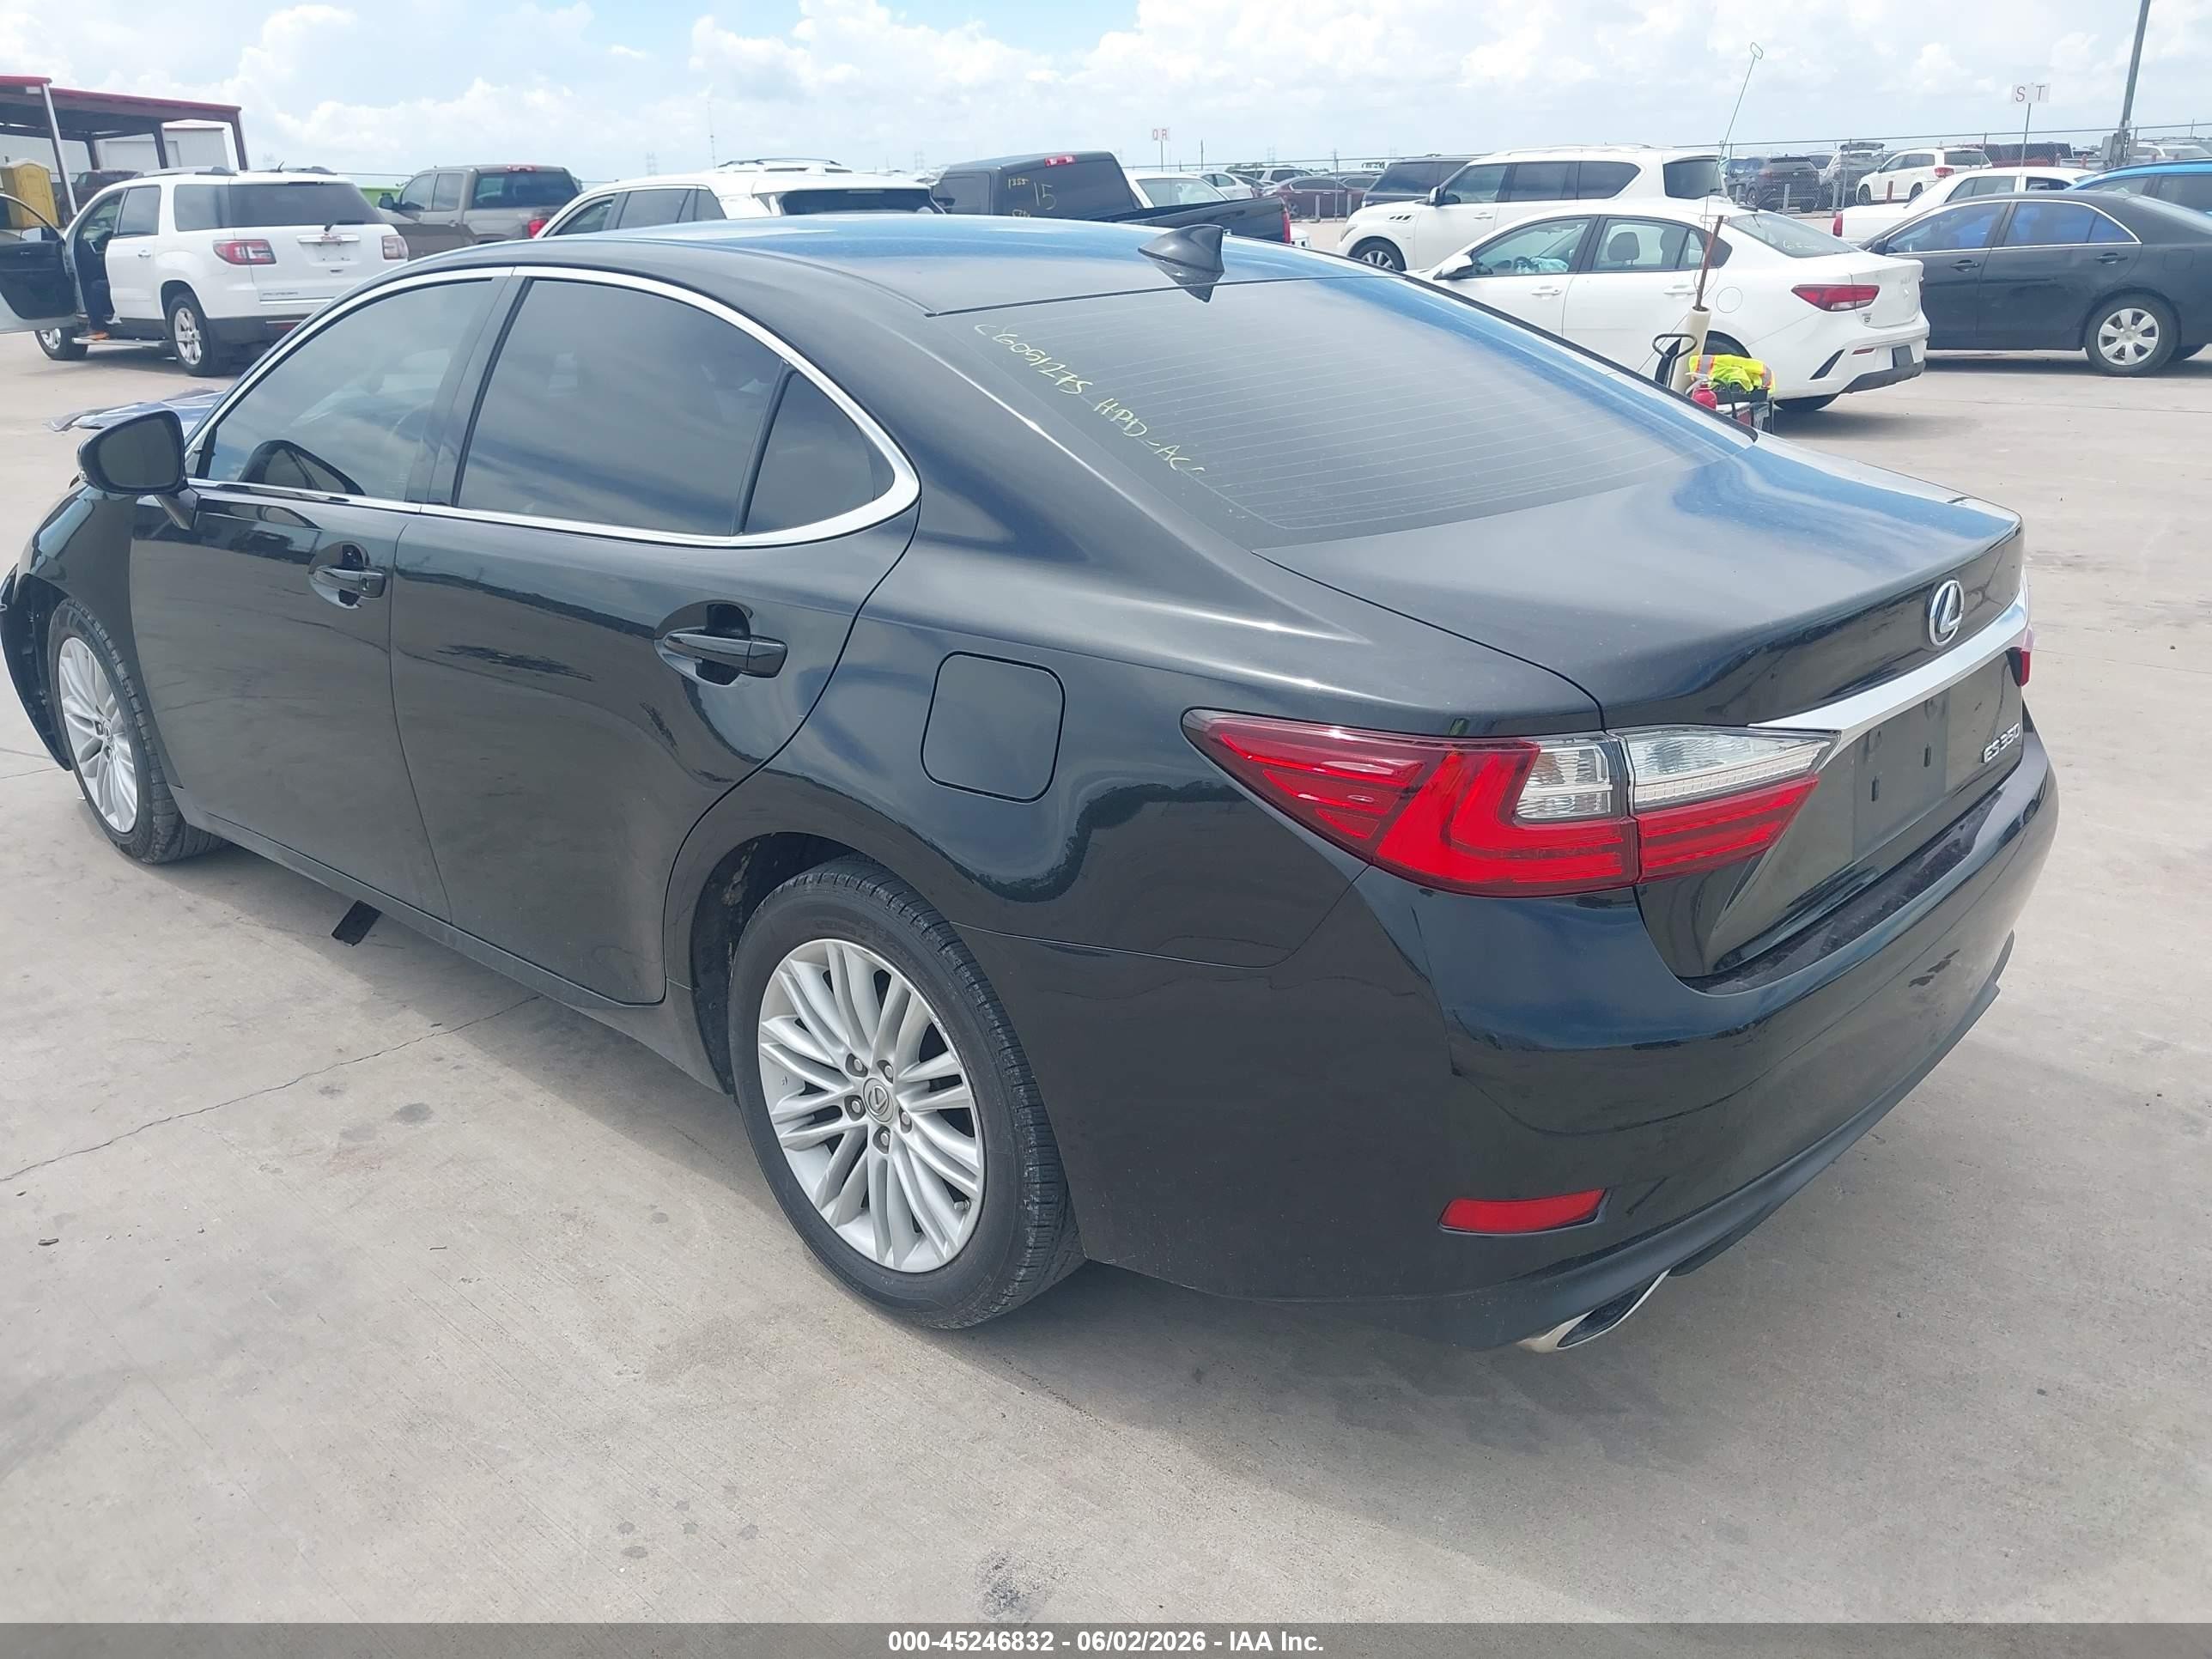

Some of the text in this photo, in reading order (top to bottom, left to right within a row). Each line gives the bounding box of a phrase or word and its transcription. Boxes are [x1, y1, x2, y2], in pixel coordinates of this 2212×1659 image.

[2015, 85, 2045, 102] S T
[1033, 181, 1057, 210] 15
